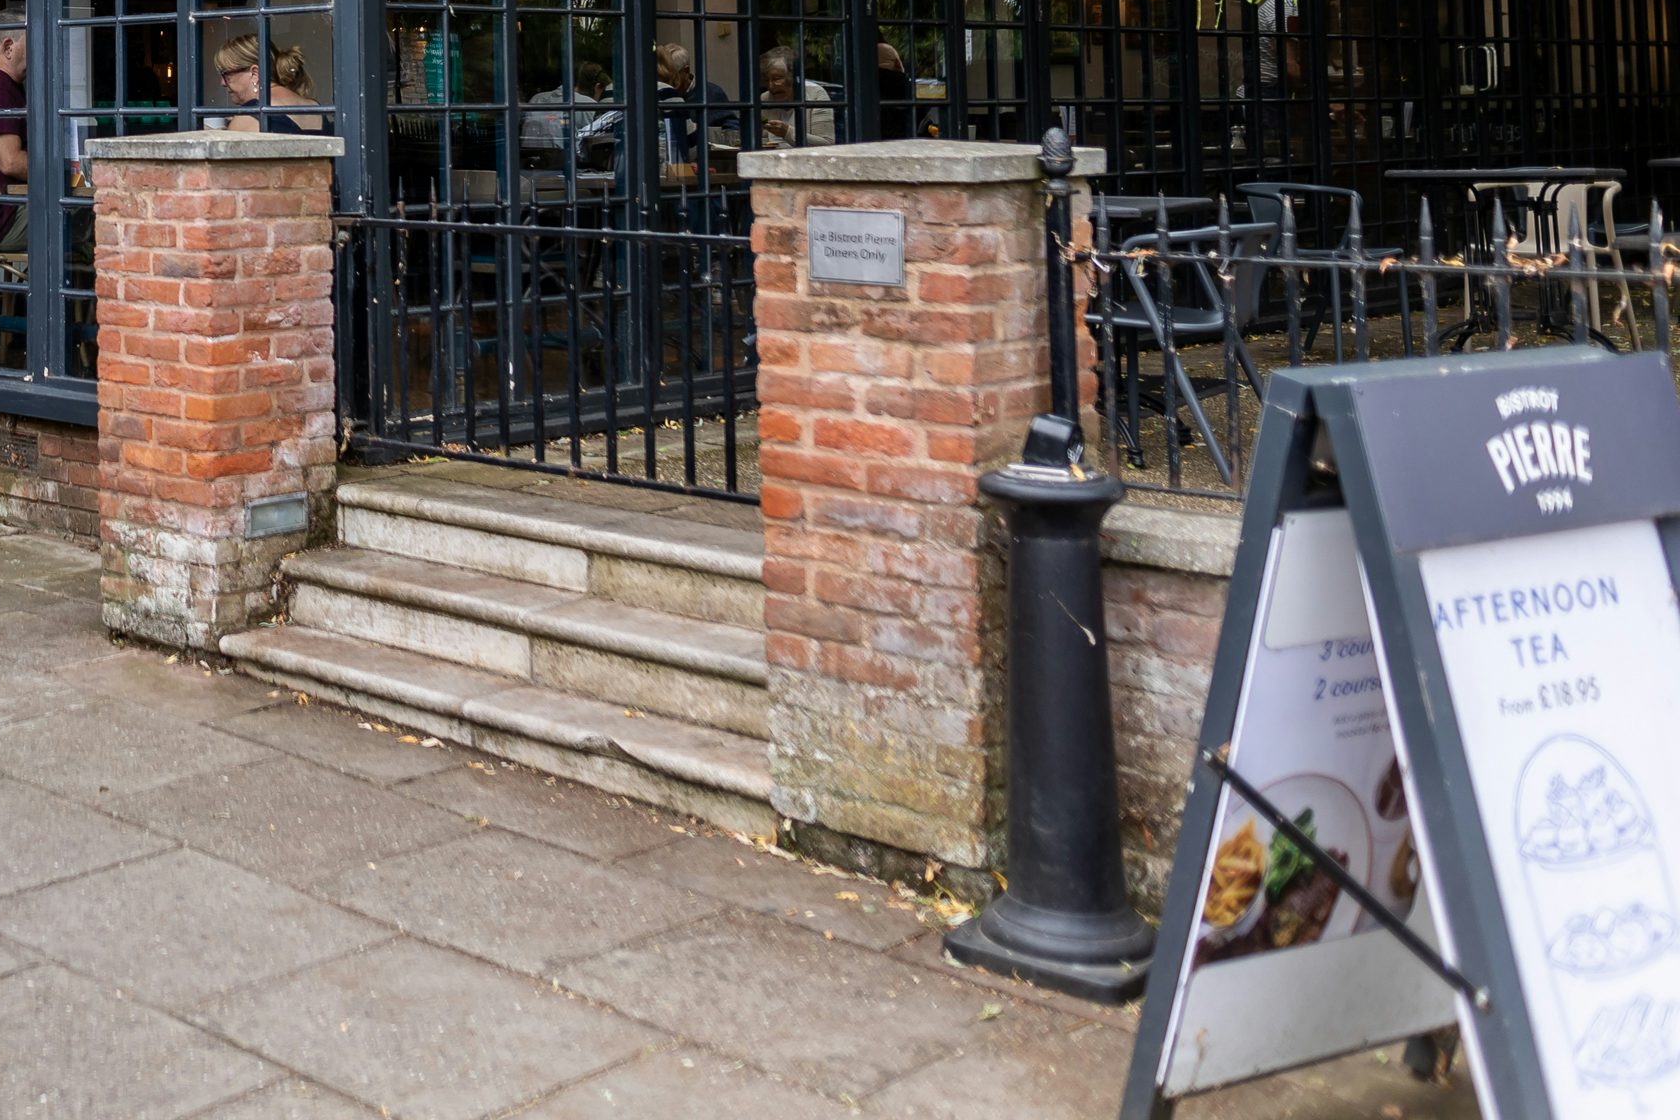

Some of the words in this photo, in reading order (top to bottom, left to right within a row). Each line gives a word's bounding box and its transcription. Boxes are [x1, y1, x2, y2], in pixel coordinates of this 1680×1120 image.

[813, 230, 827, 241] Le
[828, 231, 863, 244] Bistrot
[864, 233, 897, 246] Pierre
[823, 246, 858, 259] Diners
[860, 248, 886, 264] Only
[1495, 386, 1559, 421] BISTROT
[1486, 420, 1593, 495] PIERRE
[1433, 577, 1619, 633] AFTERNOON
[1321, 640, 1334, 661] 3
[1509, 632, 1569, 668] TEA
[1314, 677, 1327, 701] 2
[1498, 696, 1535, 716] From
[1538, 676, 1601, 711] £18.95
